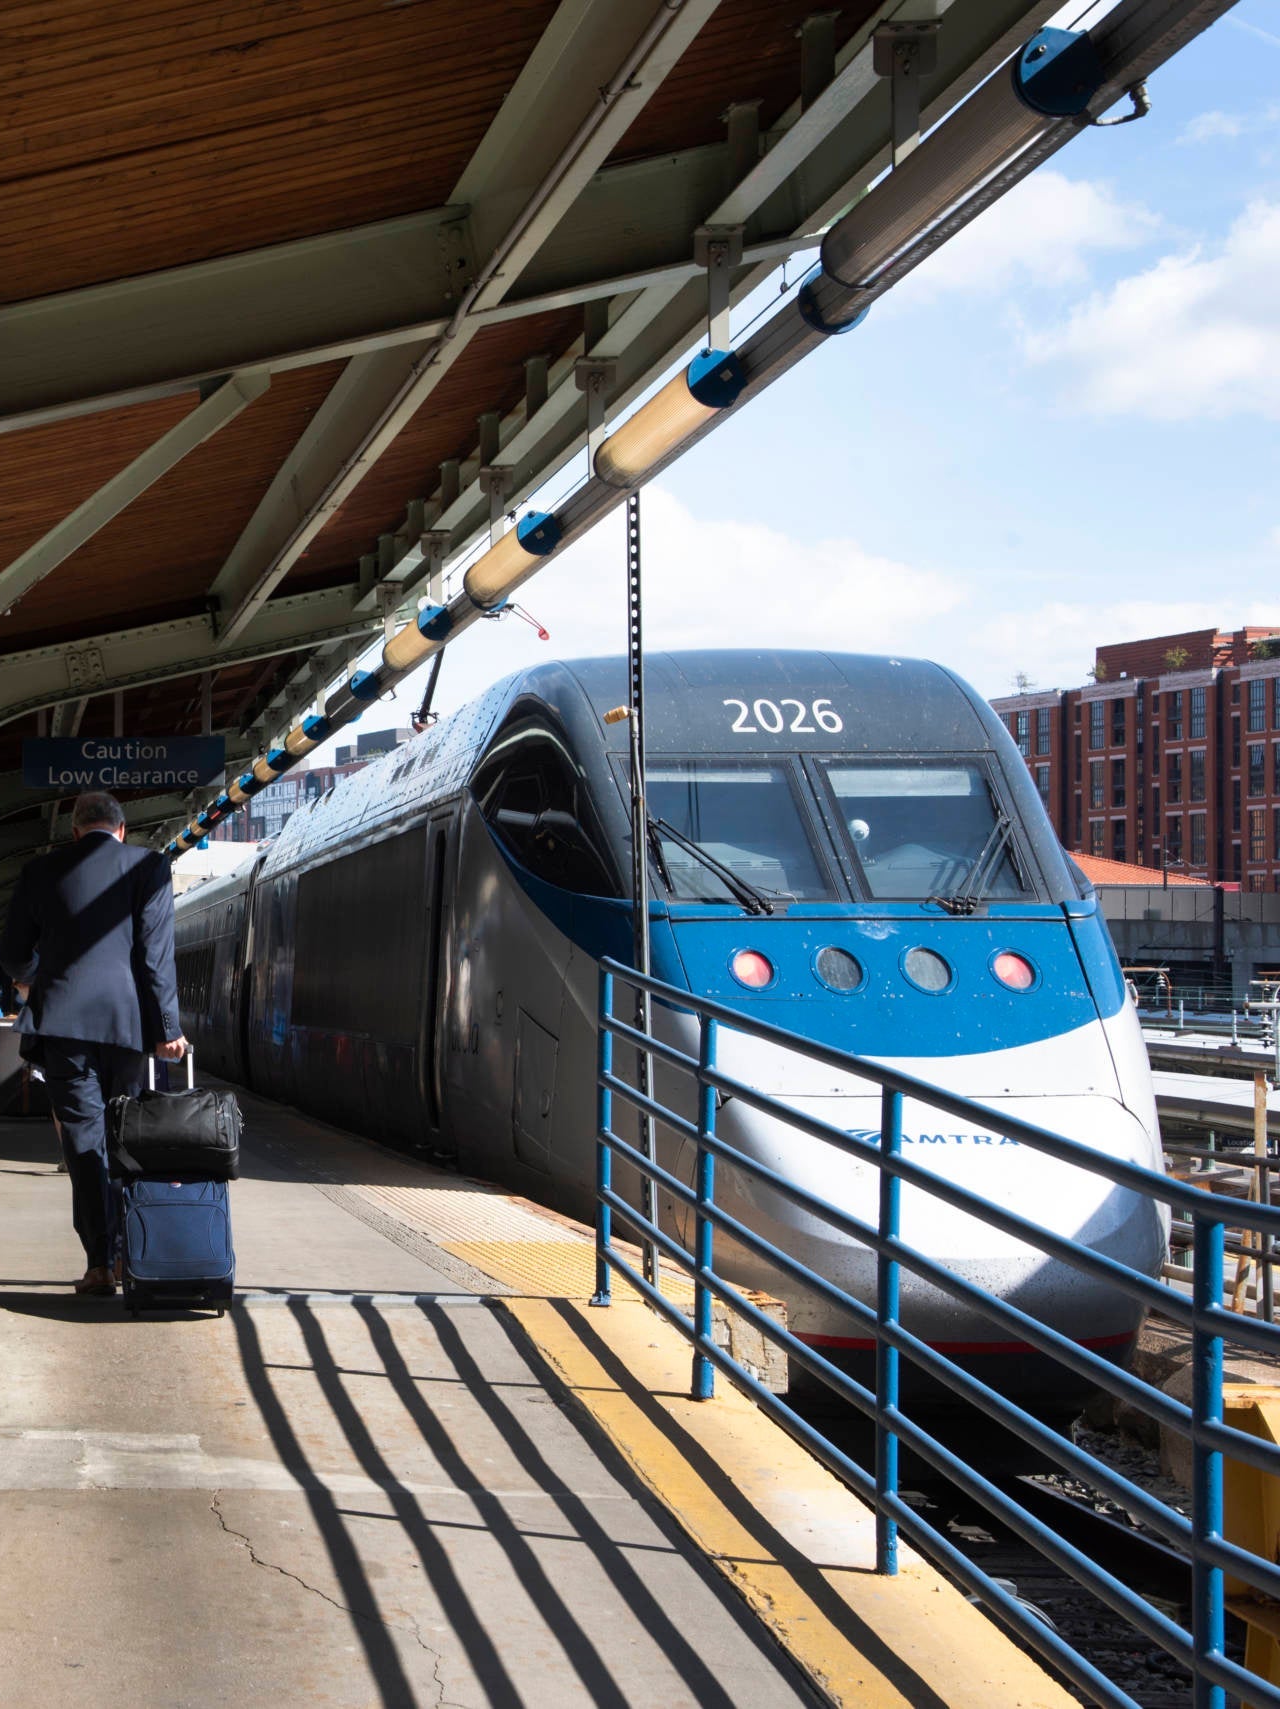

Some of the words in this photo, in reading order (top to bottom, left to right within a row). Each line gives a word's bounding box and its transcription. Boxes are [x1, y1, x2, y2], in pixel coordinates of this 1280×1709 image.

[722, 698, 844, 733] 2026
[81, 741, 168, 760] Caution
[48, 766, 94, 785] Low
[98, 766, 199, 785] Clearance
[899, 1134, 1020, 1146] AMTRA
